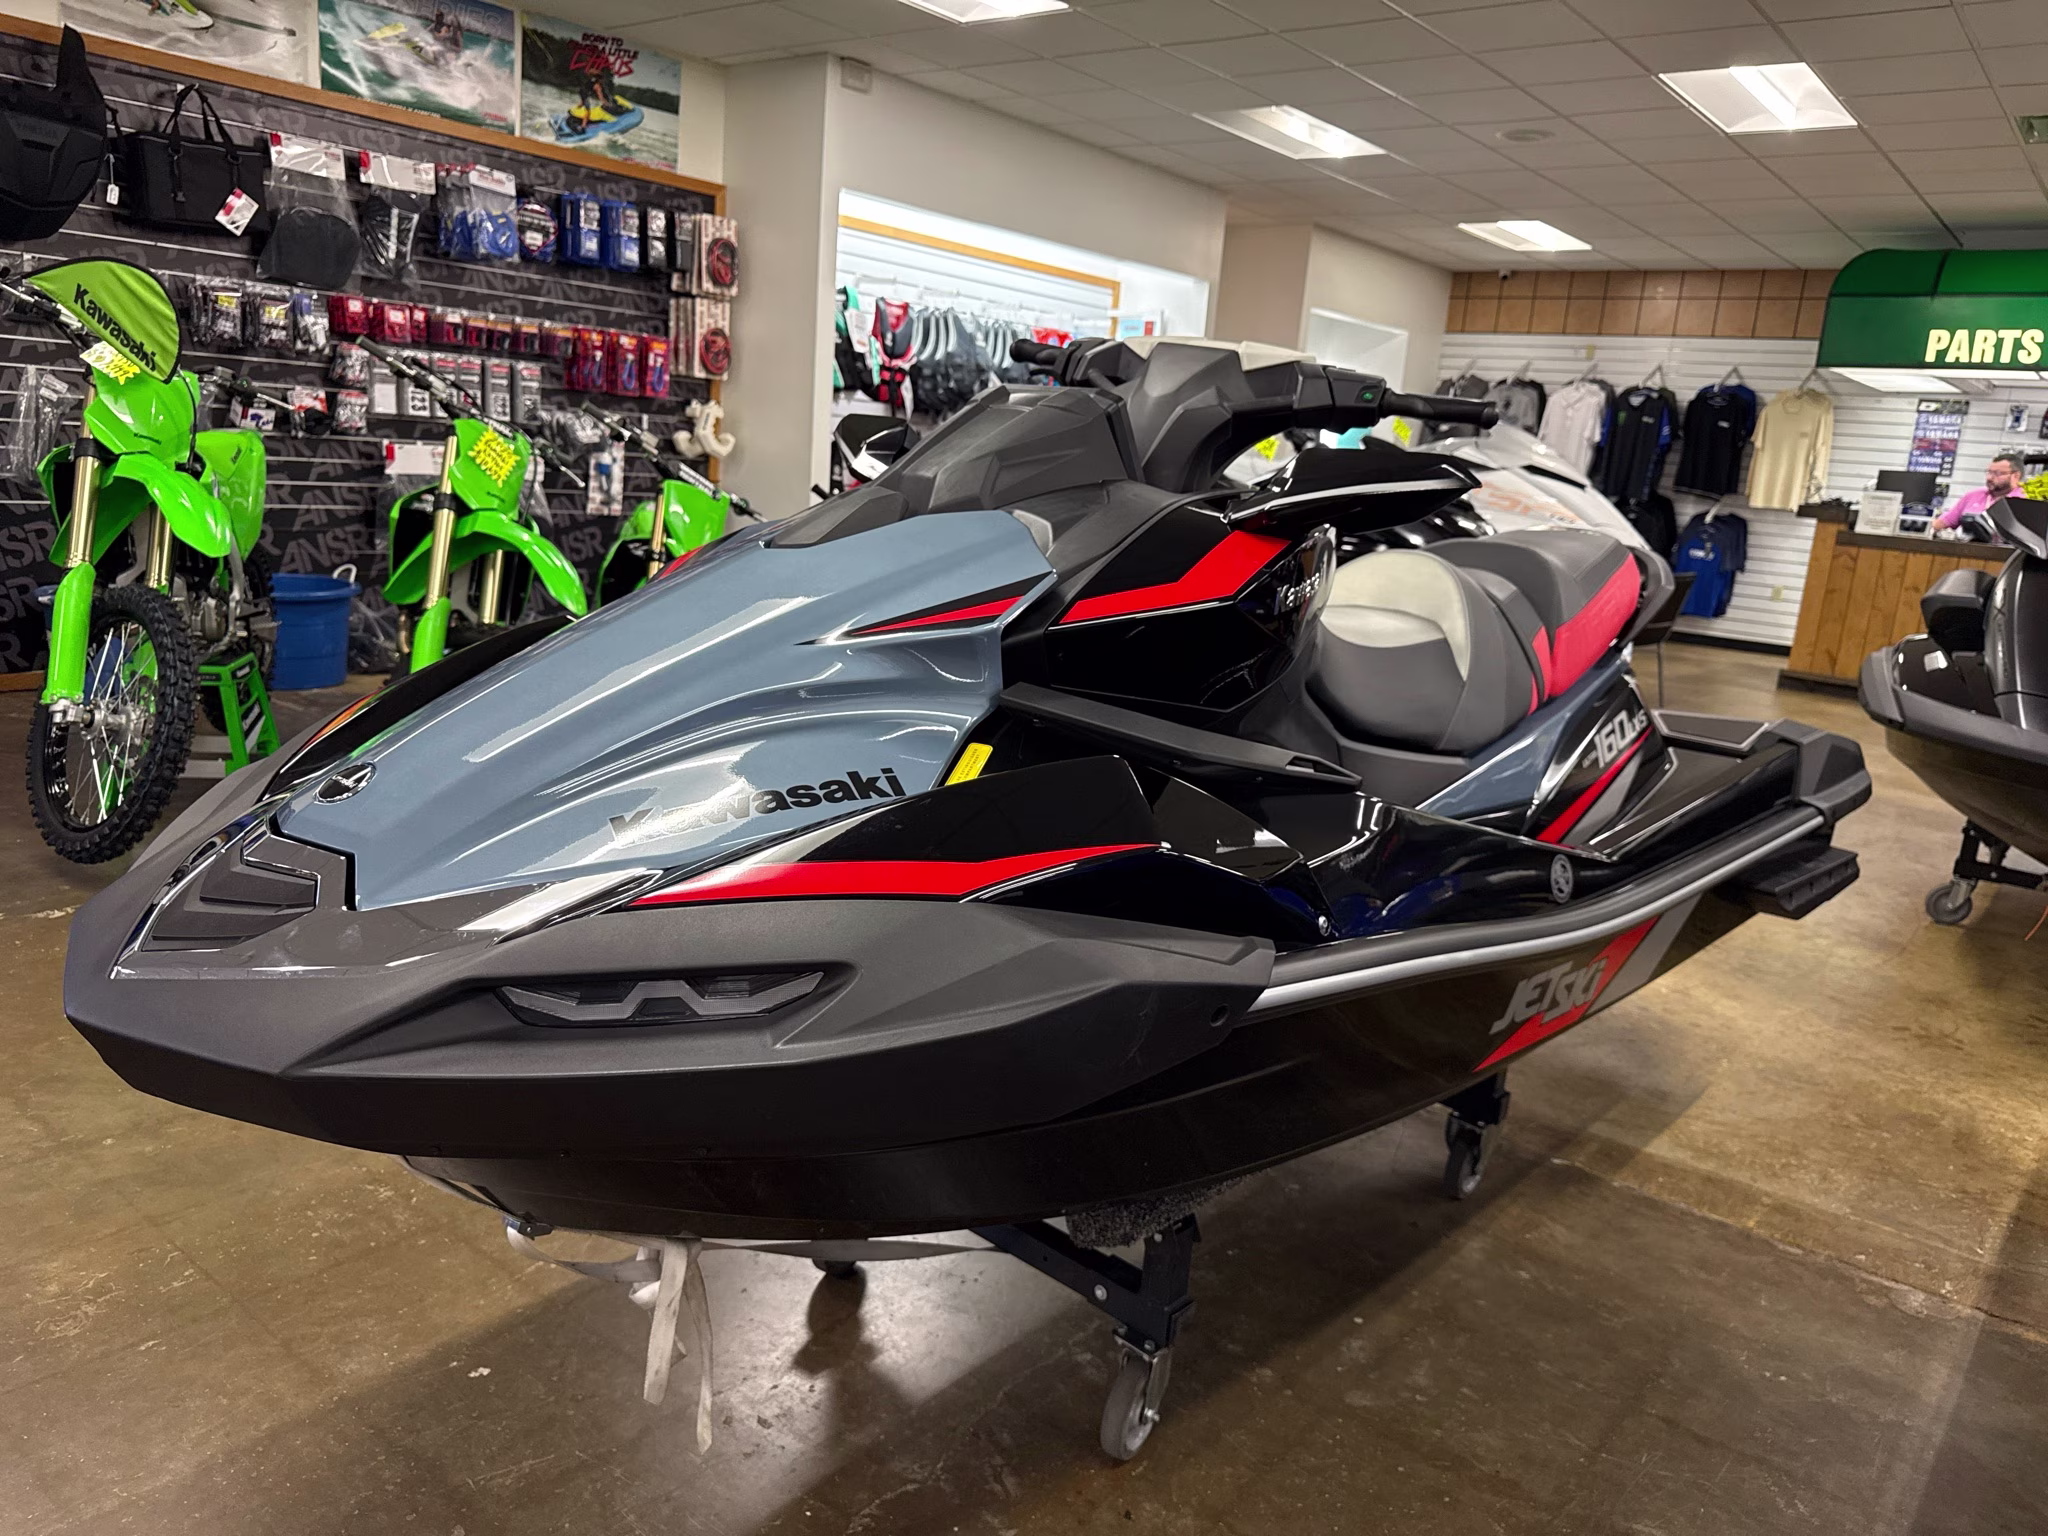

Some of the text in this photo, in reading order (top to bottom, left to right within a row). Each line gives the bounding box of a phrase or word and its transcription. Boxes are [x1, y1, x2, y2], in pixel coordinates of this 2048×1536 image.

[582, 32, 624, 47] BORN TO
[73, 283, 156, 372] Kawasaki
[1925, 328, 2045, 364] PARTS
[280, 523, 374, 573] ANSR
[609, 768, 907, 842] Kawasaki
